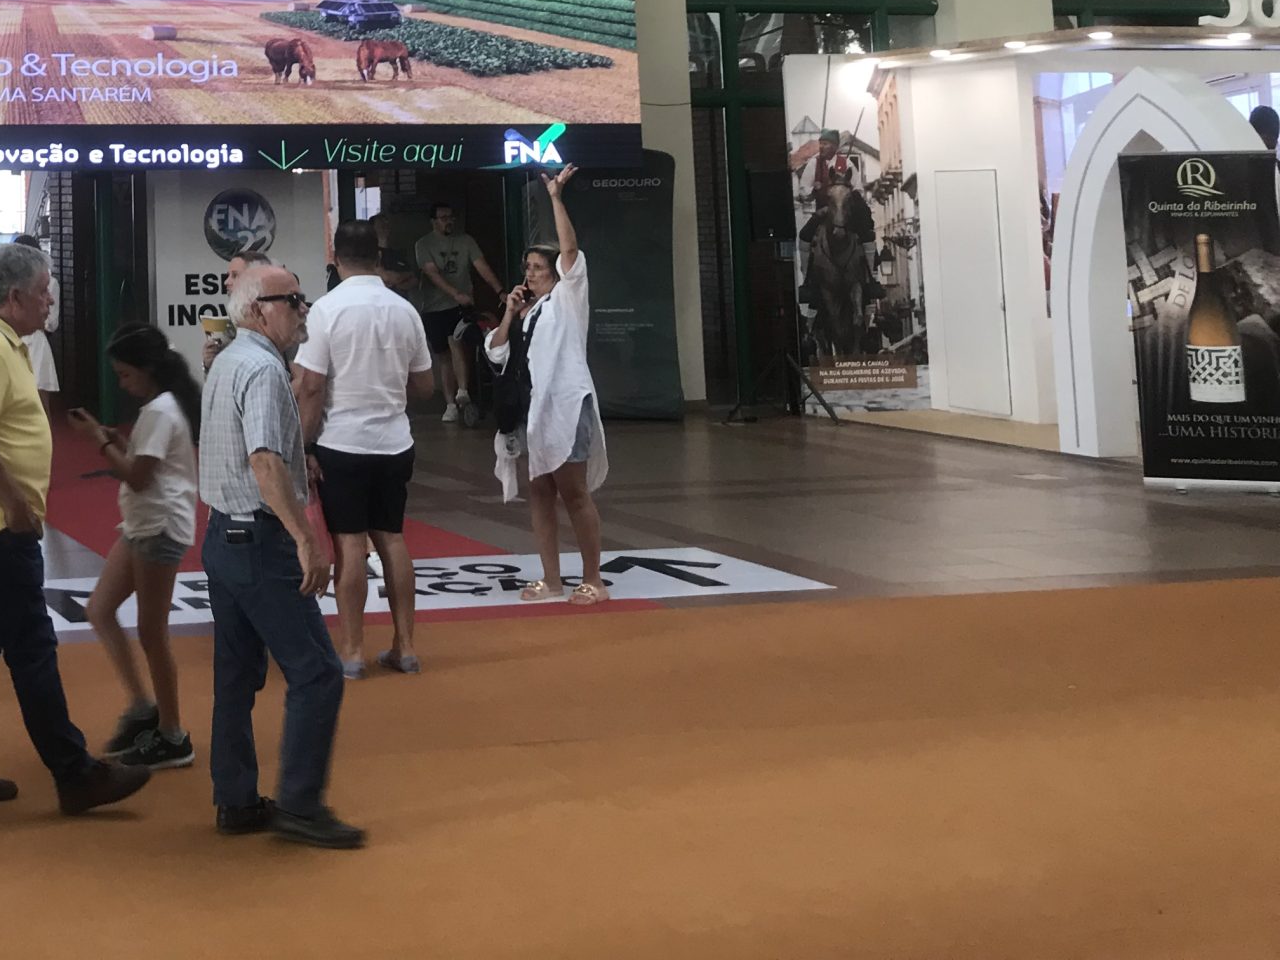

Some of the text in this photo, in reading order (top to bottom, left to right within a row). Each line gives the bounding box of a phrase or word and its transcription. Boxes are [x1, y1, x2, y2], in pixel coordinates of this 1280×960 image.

[22, 53, 47, 78] &
[51, 52, 239, 83] Tecnologia
[31, 83, 152, 103] SANTARÉM
[89, 149, 104, 165] e
[109, 143, 243, 169] Tecnologia
[324, 138, 464, 168] Visite aqui
[504, 141, 563, 164] FNA
[592, 177, 662, 188] GEODOURO
[210, 203, 272, 231] FNA
[1148, 201, 1184, 213] Quinta
[1204, 200, 1257, 211] Ribeirinha
[1167, 413, 1190, 422] MAIS
[1192, 414, 1209, 422] DO
[1251, 415, 1280, 424] VINH
